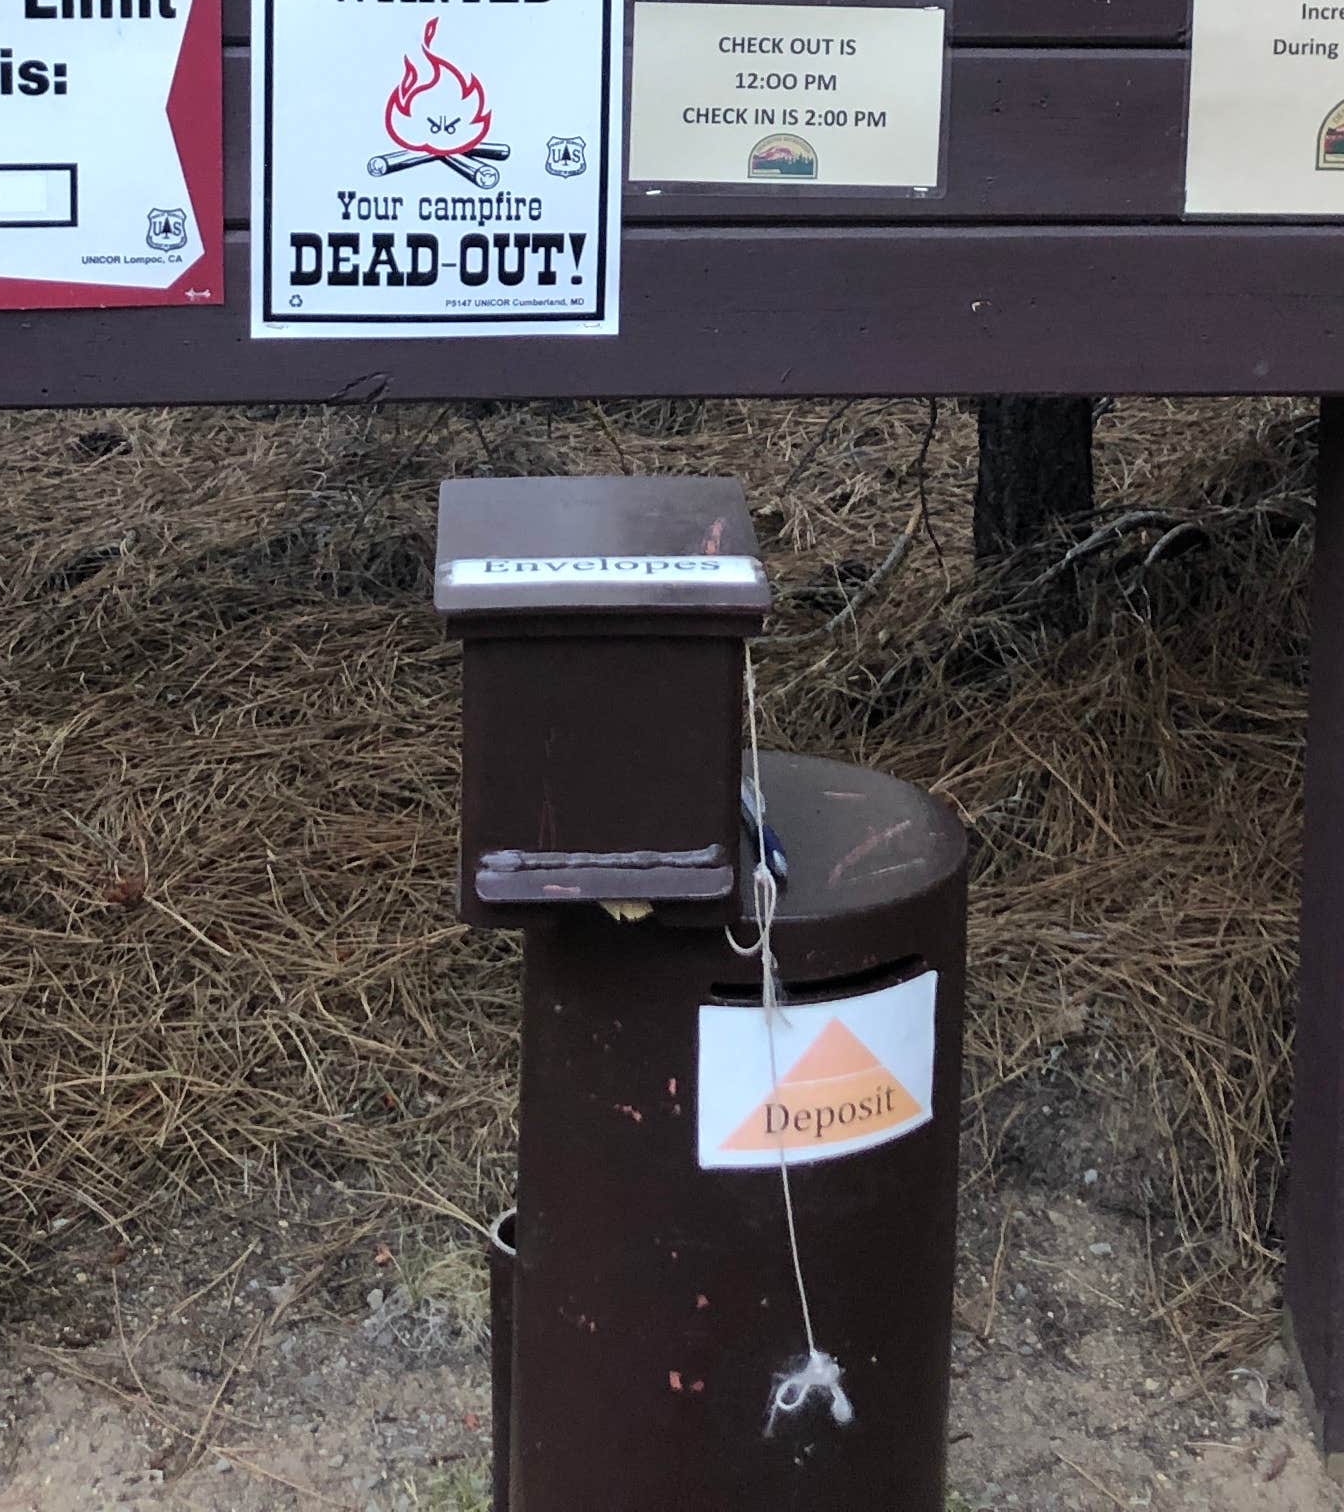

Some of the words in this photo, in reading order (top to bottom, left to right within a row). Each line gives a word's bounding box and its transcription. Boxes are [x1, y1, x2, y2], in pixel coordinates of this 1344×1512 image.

[0, 48, 67, 96] is:
[682, 107, 748, 125] CHECK
[754, 108, 775, 125] IN
[782, 108, 799, 126] IS
[804, 109, 848, 127] 2:00
[854, 110, 887, 128] PM
[337, 190, 404, 221] Your
[418, 191, 542, 227] campfire
[81, 255, 121, 265] UNICOR
[123, 255, 166, 266] Lompoc,
[167, 254, 183, 264] CA
[289, 232, 587, 287] DEAD-OUT!
[474, 298, 511, 308] UNICOR
[570, 297, 585, 306] MD
[483, 557, 722, 575] Envelopes
[766, 1086, 895, 1138] Deposit
